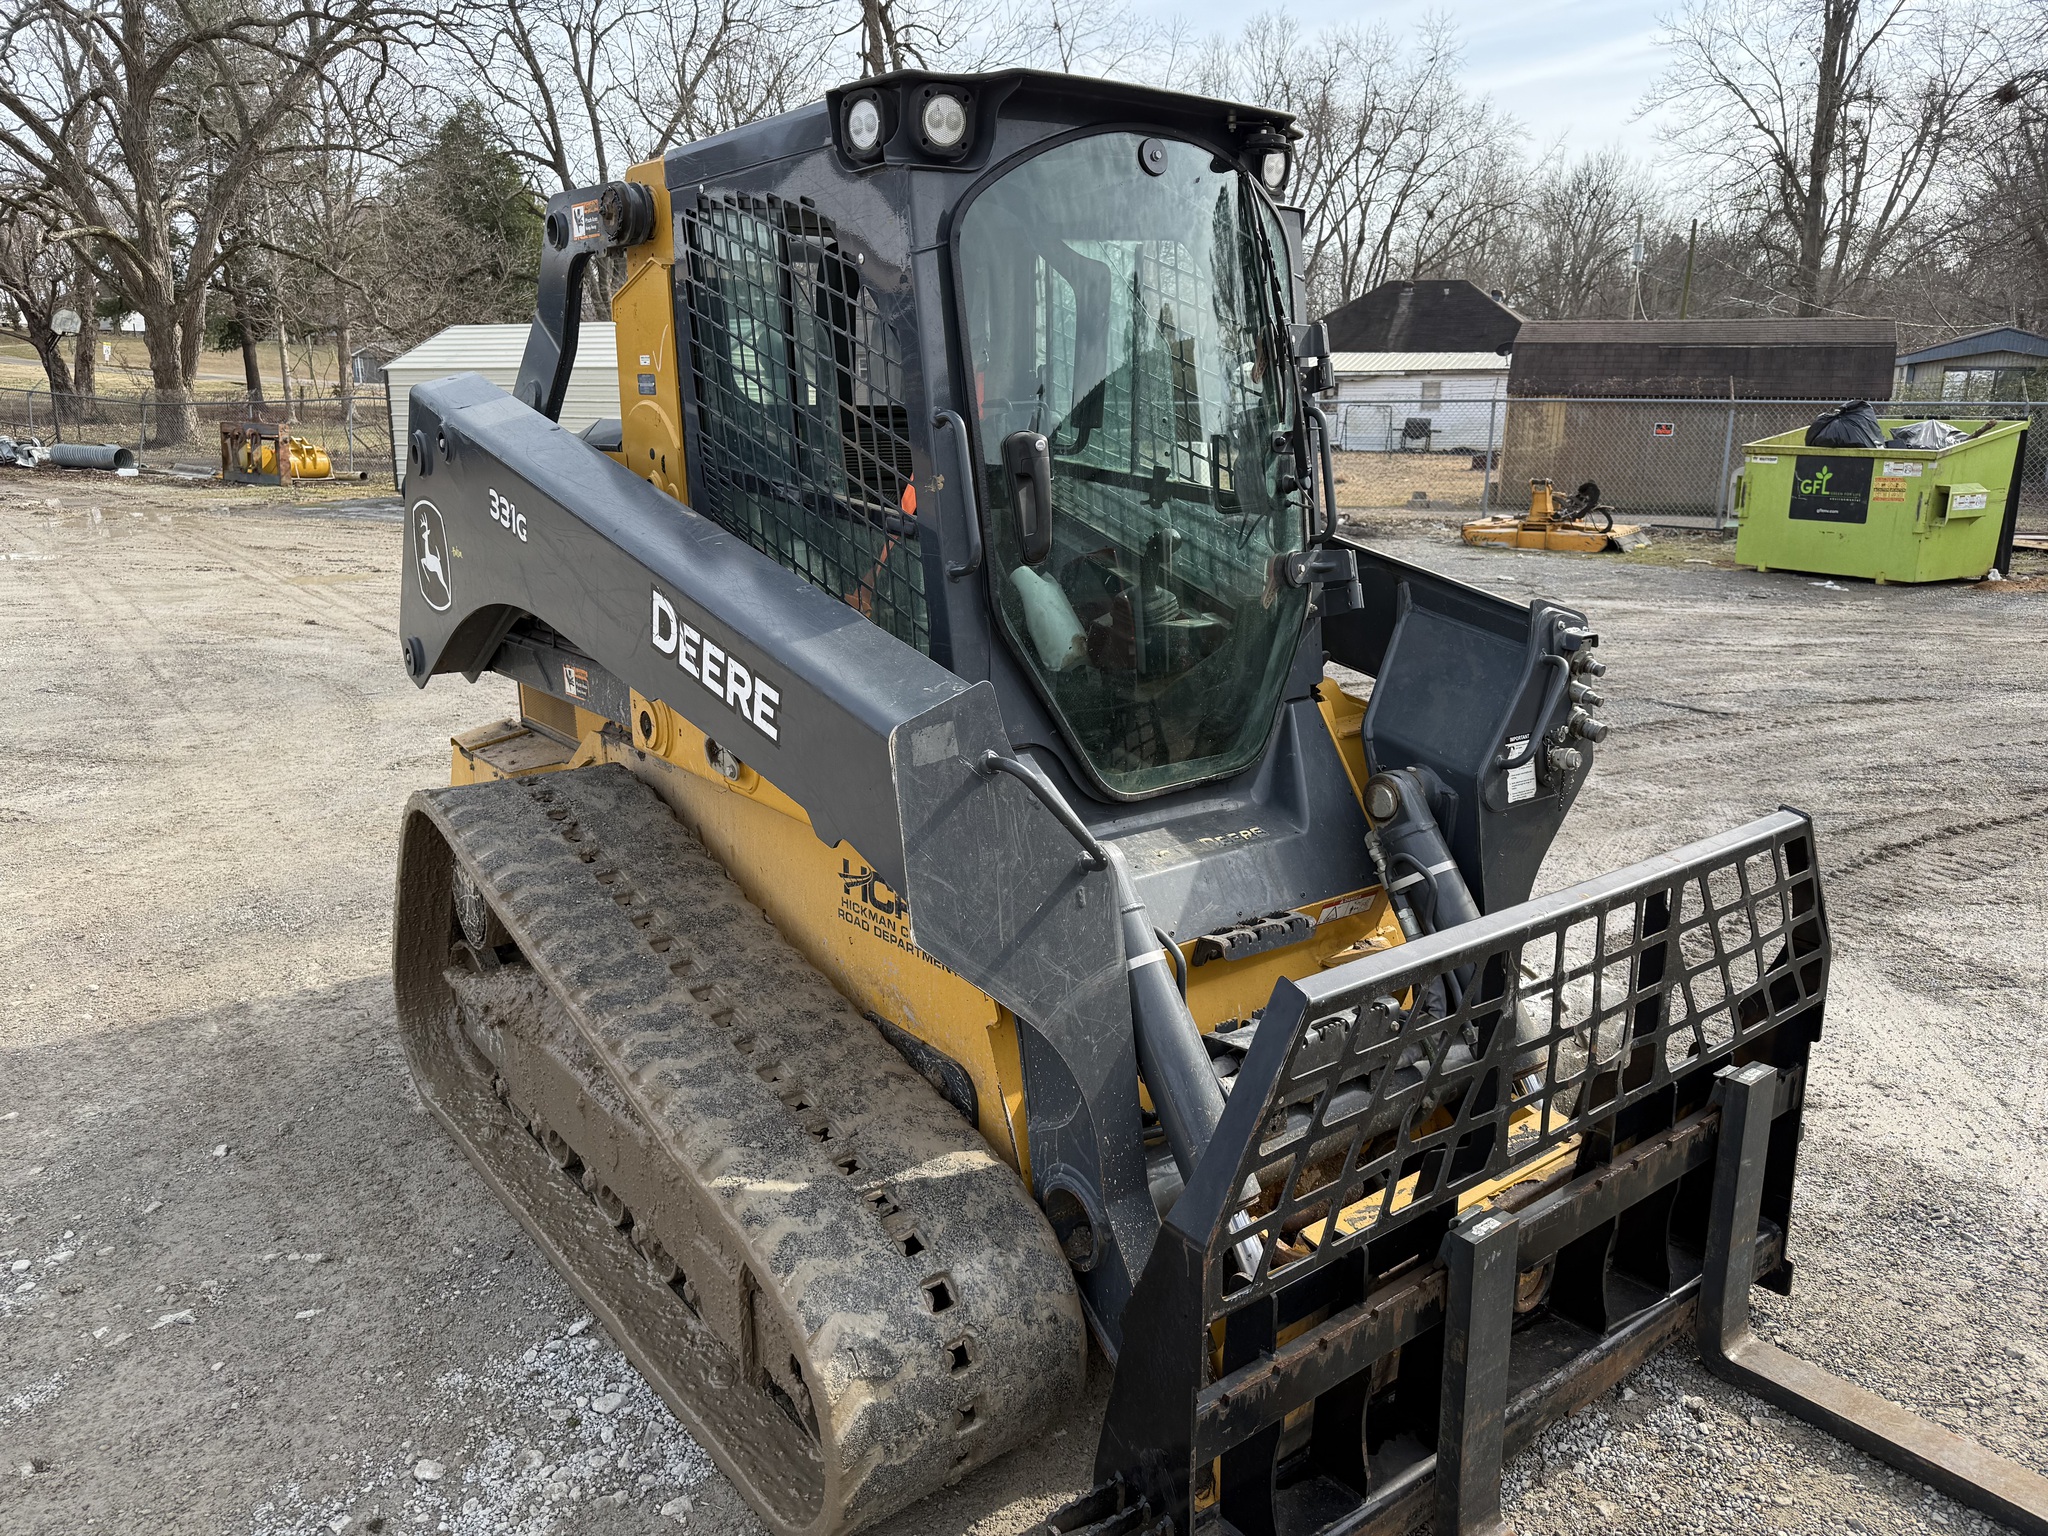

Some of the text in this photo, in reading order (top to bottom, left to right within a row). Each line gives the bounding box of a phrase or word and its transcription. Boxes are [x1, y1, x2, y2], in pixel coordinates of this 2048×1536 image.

[1800, 472, 1830, 495] GFL
[489, 488, 528, 542] 331G
[652, 589, 780, 742] DEERE
[1509, 733, 1530, 743] IMPORTANT
[1196, 825, 1270, 848] DEERE
[841, 897, 896, 932] HICKMAN
[838, 908, 957, 977] ROAD DEPARTME
